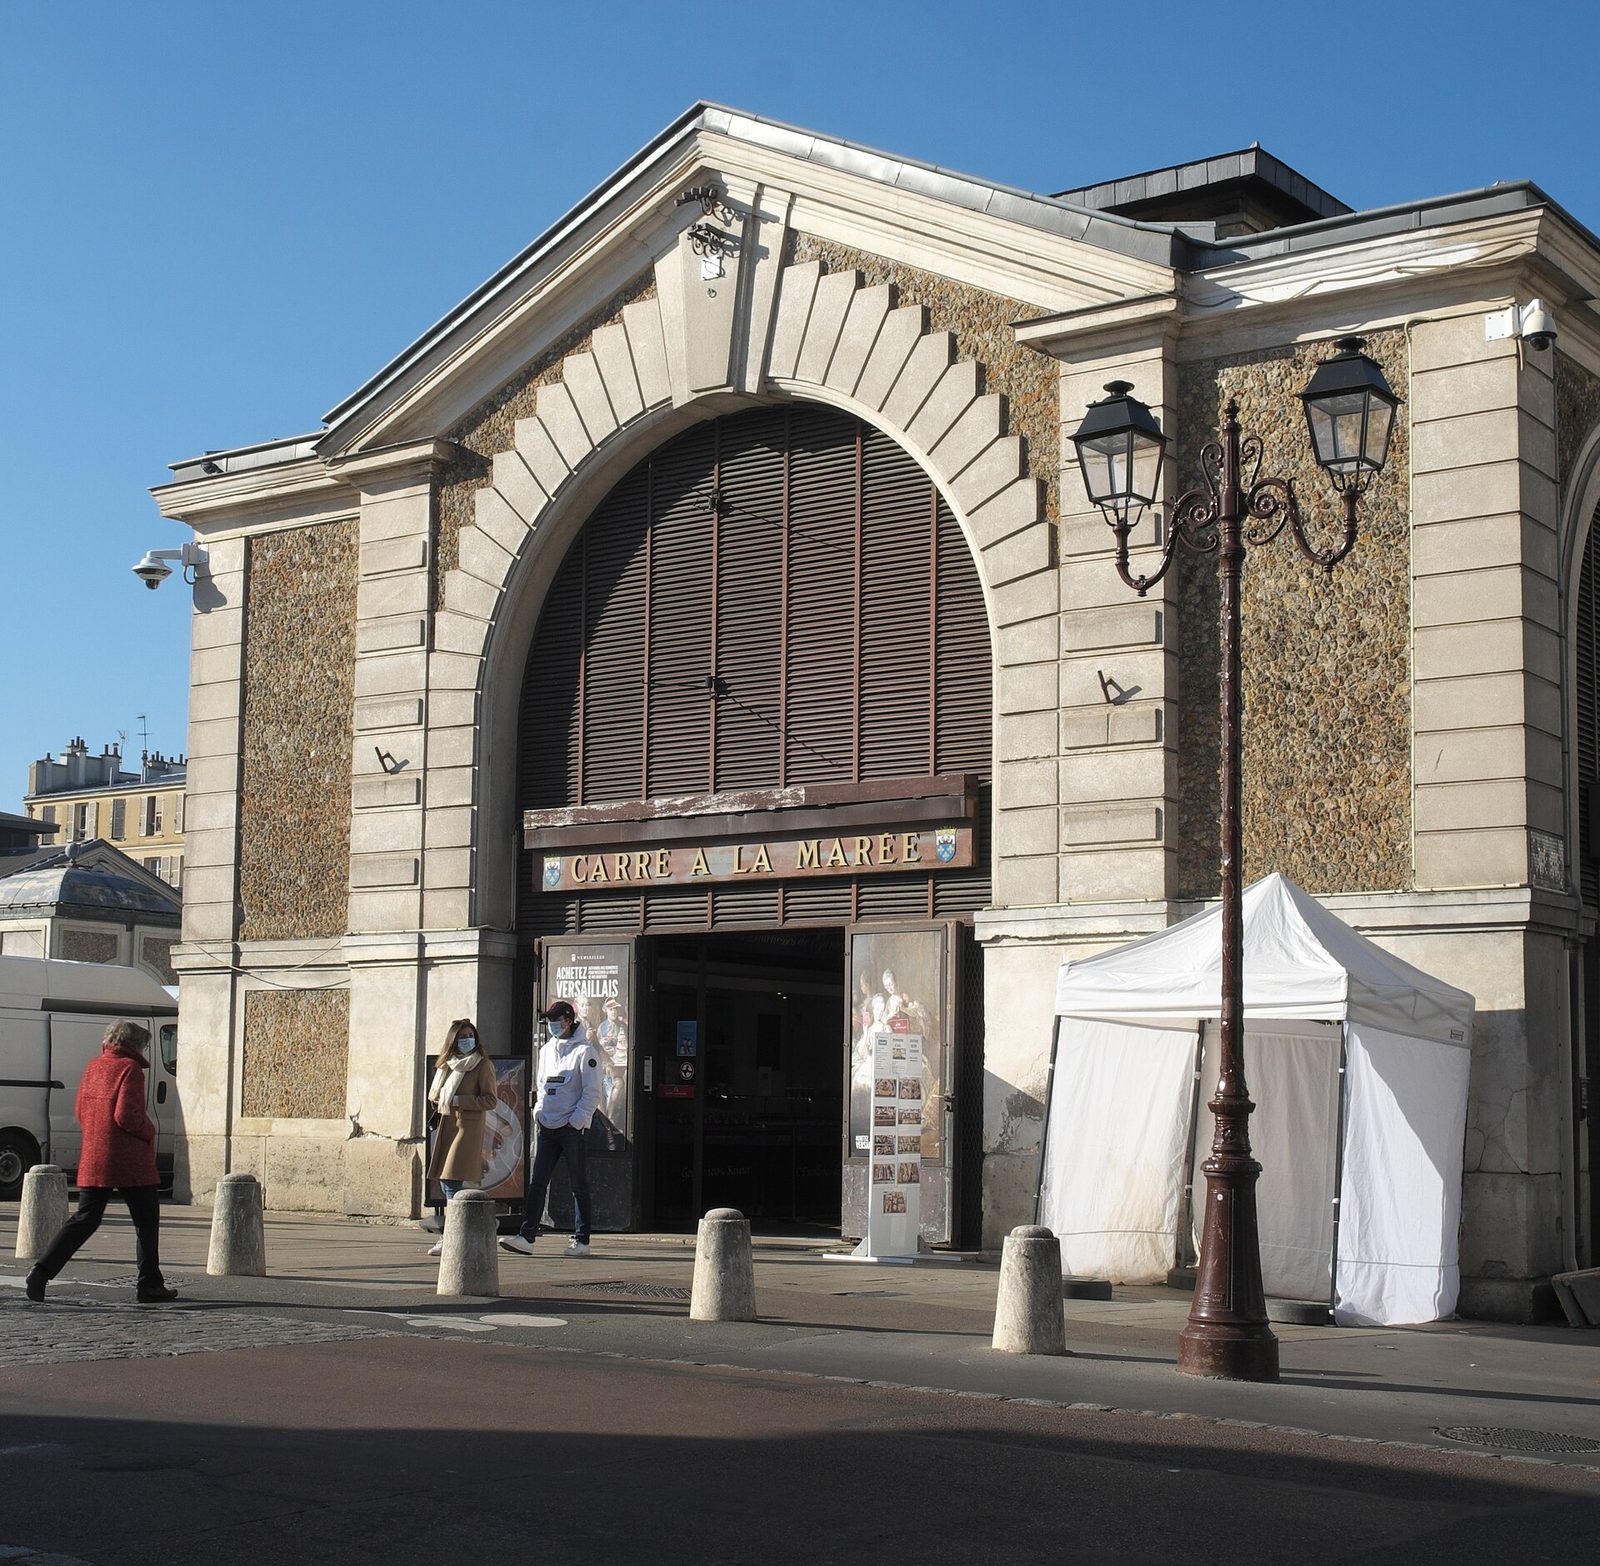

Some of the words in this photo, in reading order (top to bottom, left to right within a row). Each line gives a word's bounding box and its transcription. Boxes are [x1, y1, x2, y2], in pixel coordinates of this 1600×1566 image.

[570, 848, 672, 883] CARRÉ
[690, 847, 711, 876] A
[733, 844, 774, 874] LA
[795, 832, 922, 869] MARÉE
[556, 966, 587, 979] ACHETEZ
[556, 980, 619, 998] VERSAILLAIS
